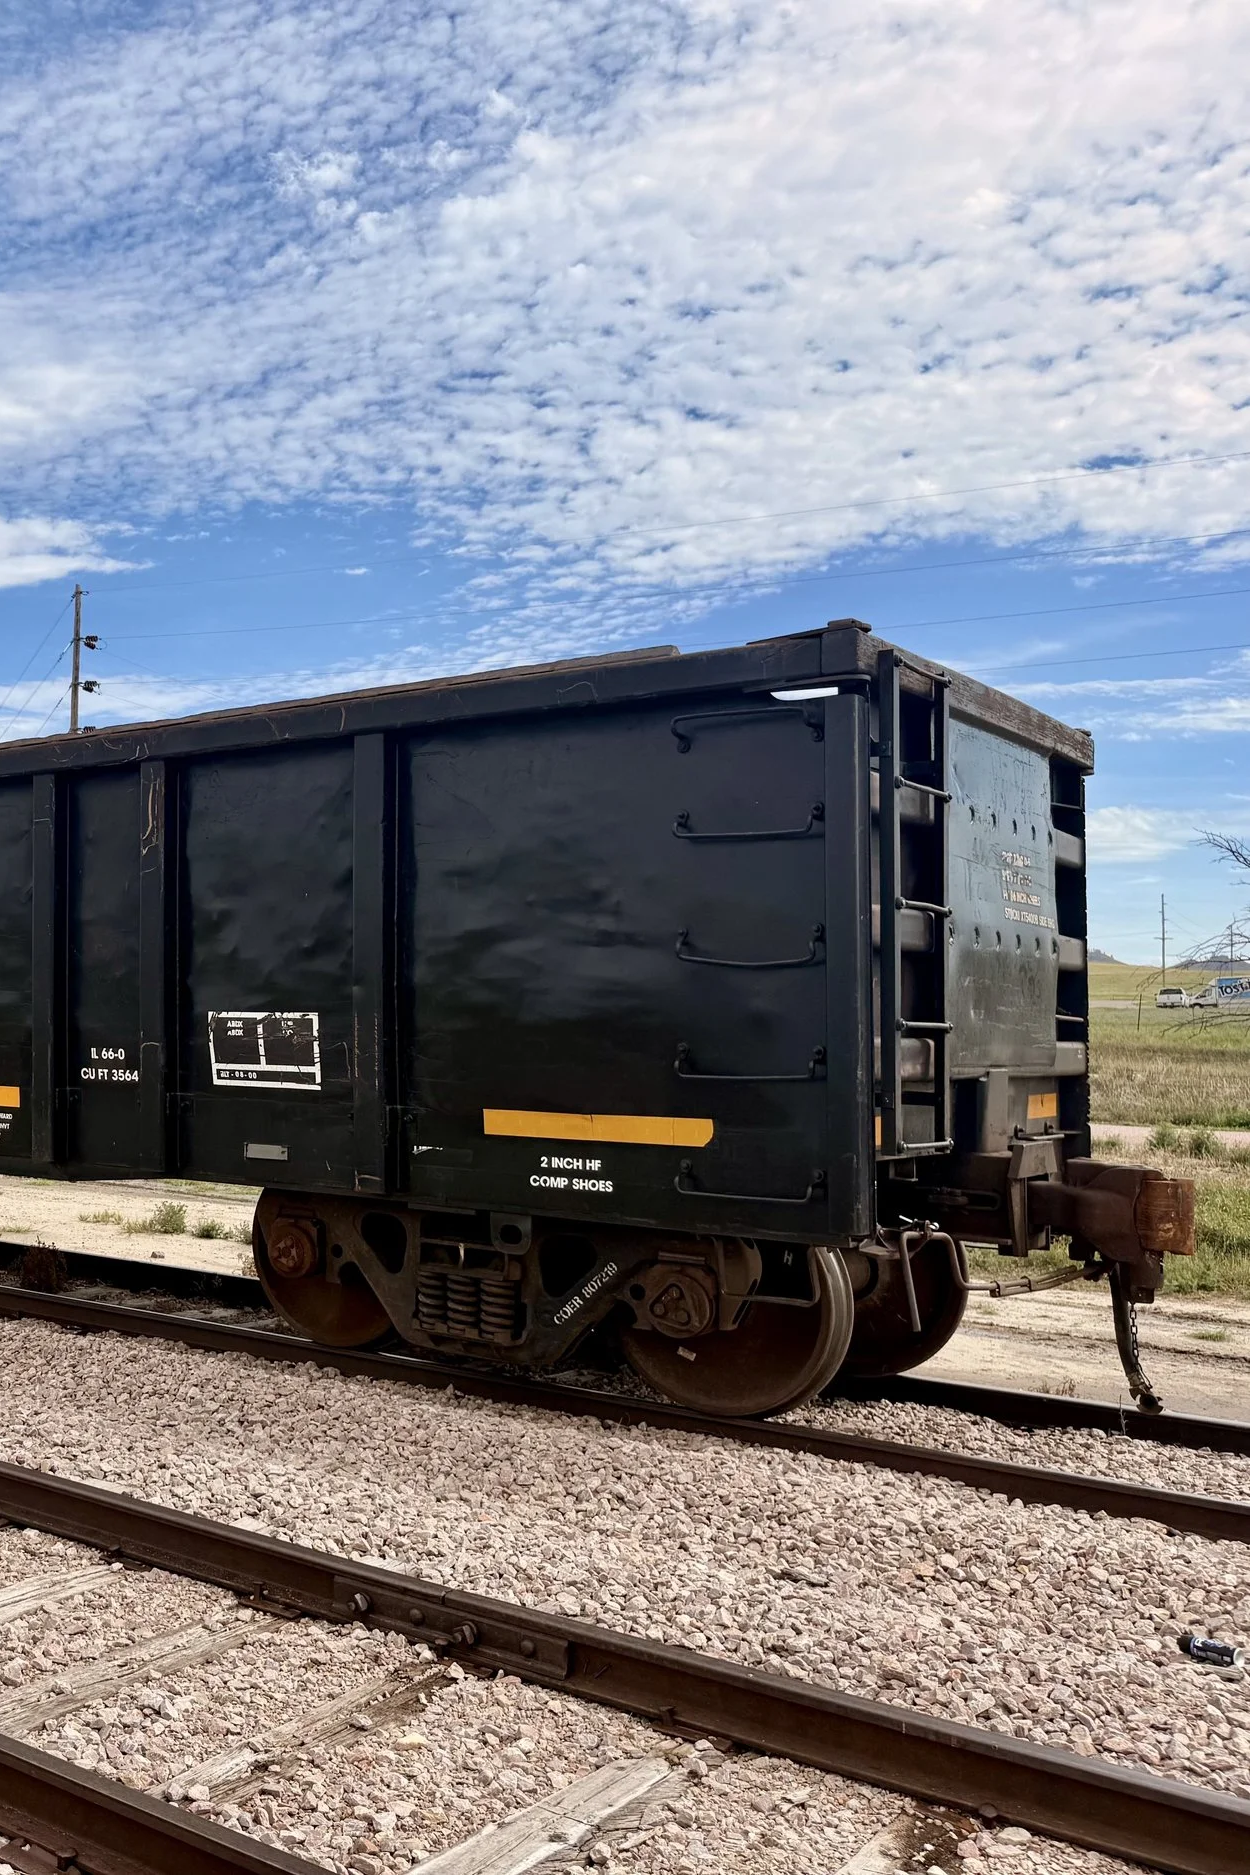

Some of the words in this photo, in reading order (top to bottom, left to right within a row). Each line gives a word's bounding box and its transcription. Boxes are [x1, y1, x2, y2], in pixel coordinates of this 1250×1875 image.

[101, 1047, 125, 1060] 66-0
[80, 1067, 96, 1080] CU
[97, 1068, 109, 1080] FT
[111, 1068, 139, 1082] 3564
[540, 1156, 548, 1168] 2
[551, 1156, 583, 1170] INCH
[585, 1159, 602, 1171] HF
[529, 1175, 569, 1189] COMP
[572, 1178, 614, 1193] SHOES
[553, 1296, 584, 1325] COER
[581, 1262, 618, 1298] 807219
